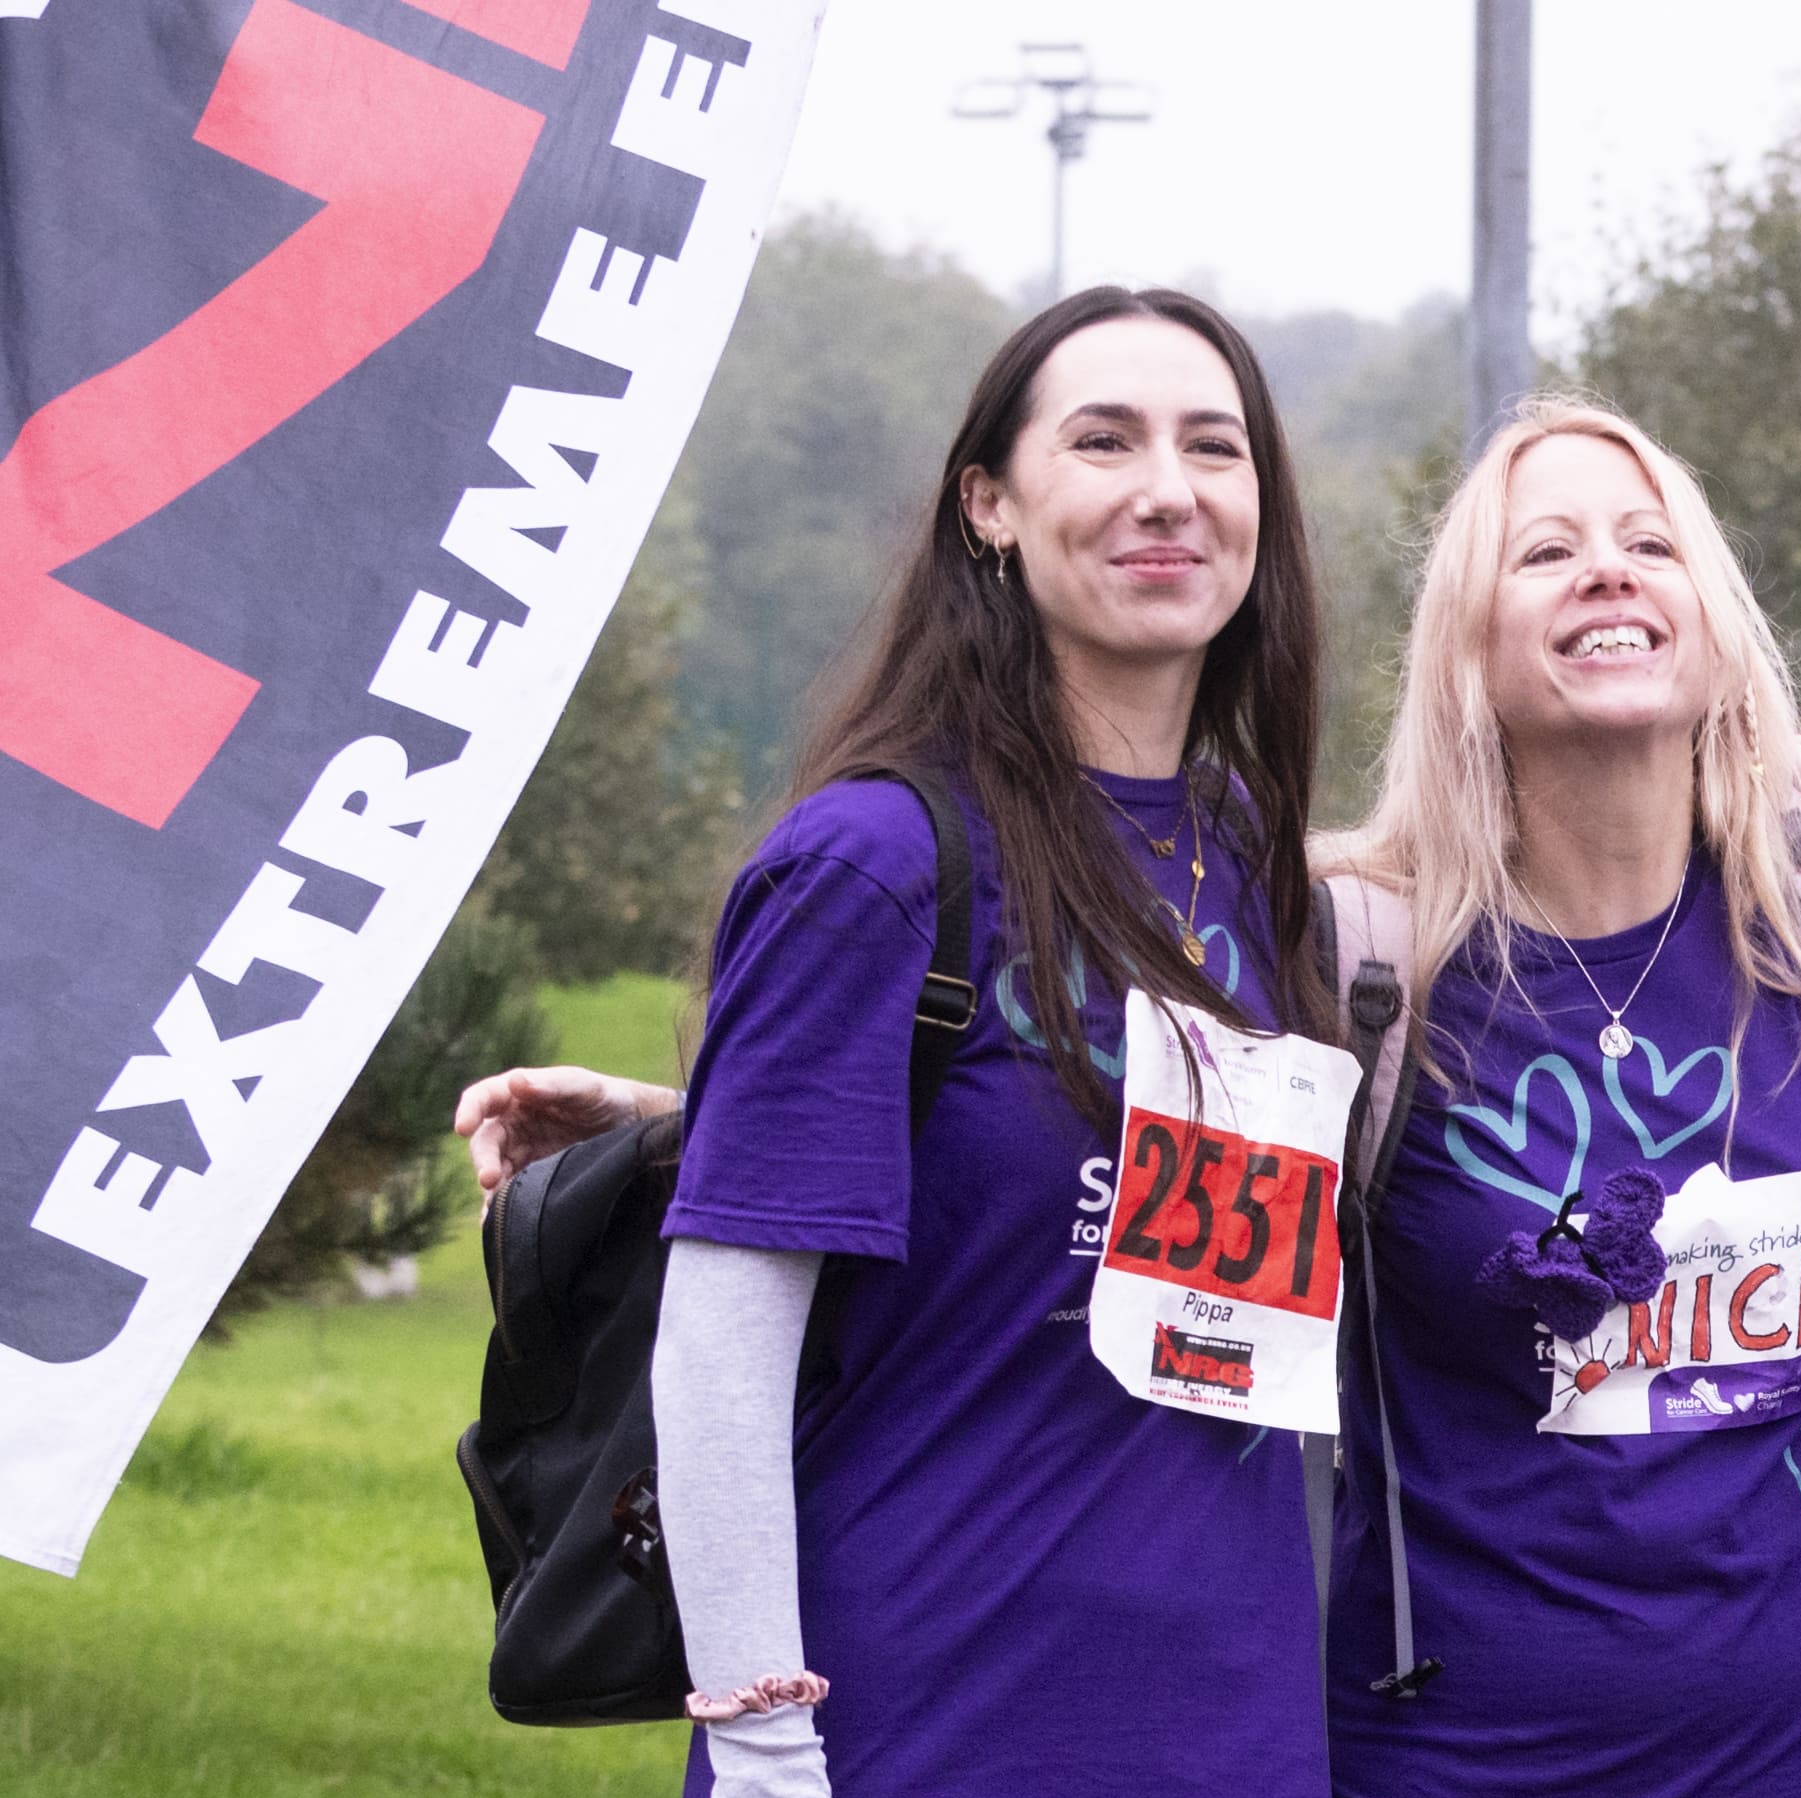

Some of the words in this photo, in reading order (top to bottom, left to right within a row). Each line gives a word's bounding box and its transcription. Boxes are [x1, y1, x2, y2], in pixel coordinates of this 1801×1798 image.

[31, 226, 678, 1281] EXTREME
[1077, 1157, 1113, 1213] S
[1114, 1123, 1325, 1298] 2551
[1183, 1290, 1235, 1325] Pippa
[1665, 1398, 1702, 1410] Stride
